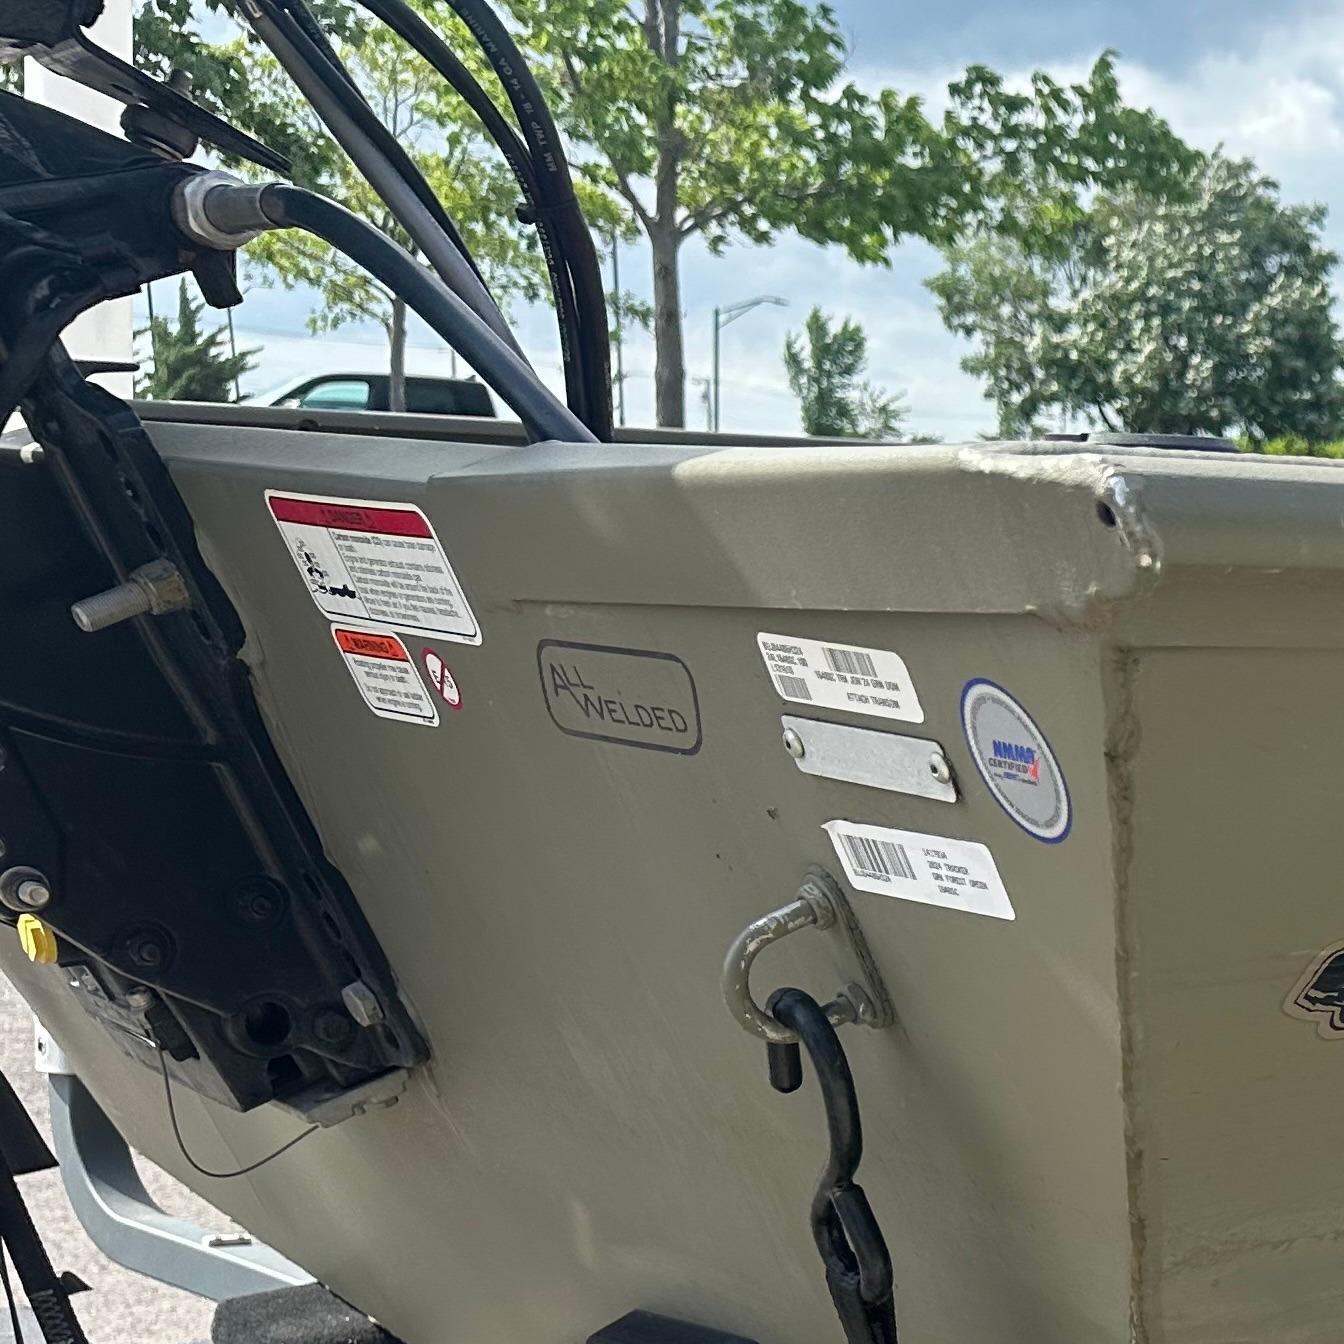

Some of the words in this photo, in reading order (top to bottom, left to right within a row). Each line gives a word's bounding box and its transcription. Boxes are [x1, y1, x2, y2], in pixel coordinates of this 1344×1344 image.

[459, 6, 499, 54] MARINE
[549, 662, 594, 697] ALL
[568, 688, 688, 733] WELDED
